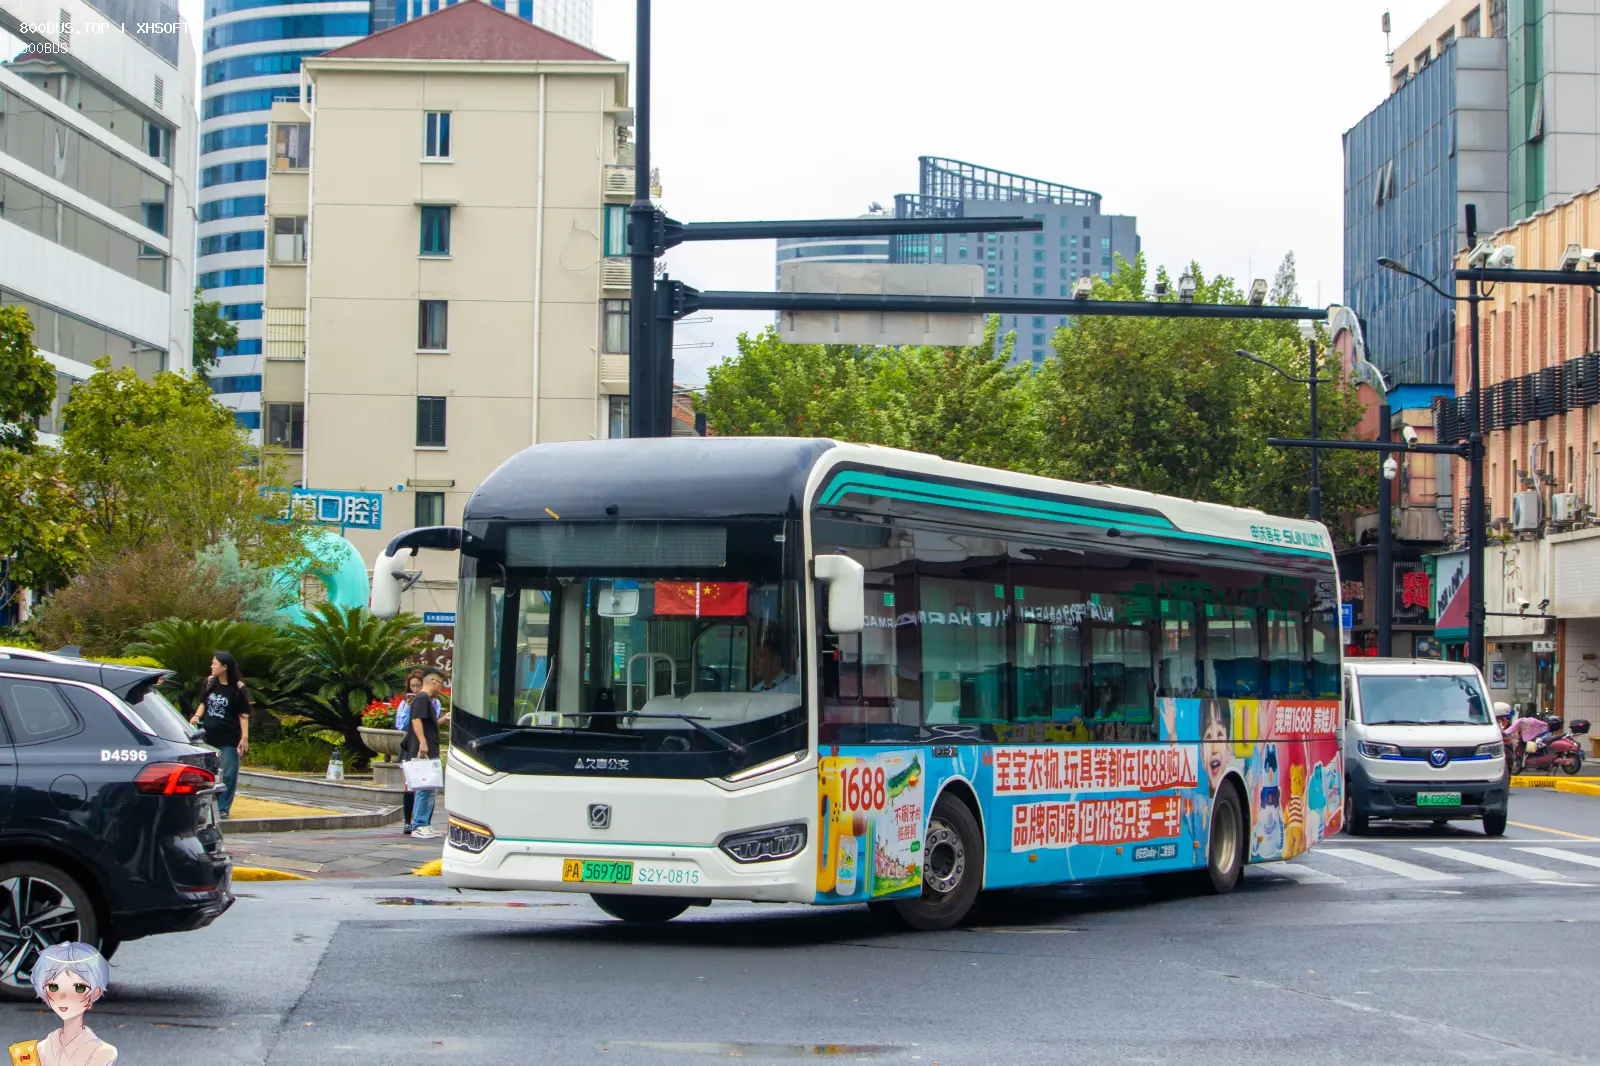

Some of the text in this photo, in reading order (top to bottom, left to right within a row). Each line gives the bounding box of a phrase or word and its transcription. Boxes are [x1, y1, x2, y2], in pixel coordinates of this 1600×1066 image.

[1283, 529, 1325, 548] SUNWIN
[101, 749, 148, 762] D4596
[840, 766, 885, 812] 1688
[638, 867, 699, 884] S2Y-0815
